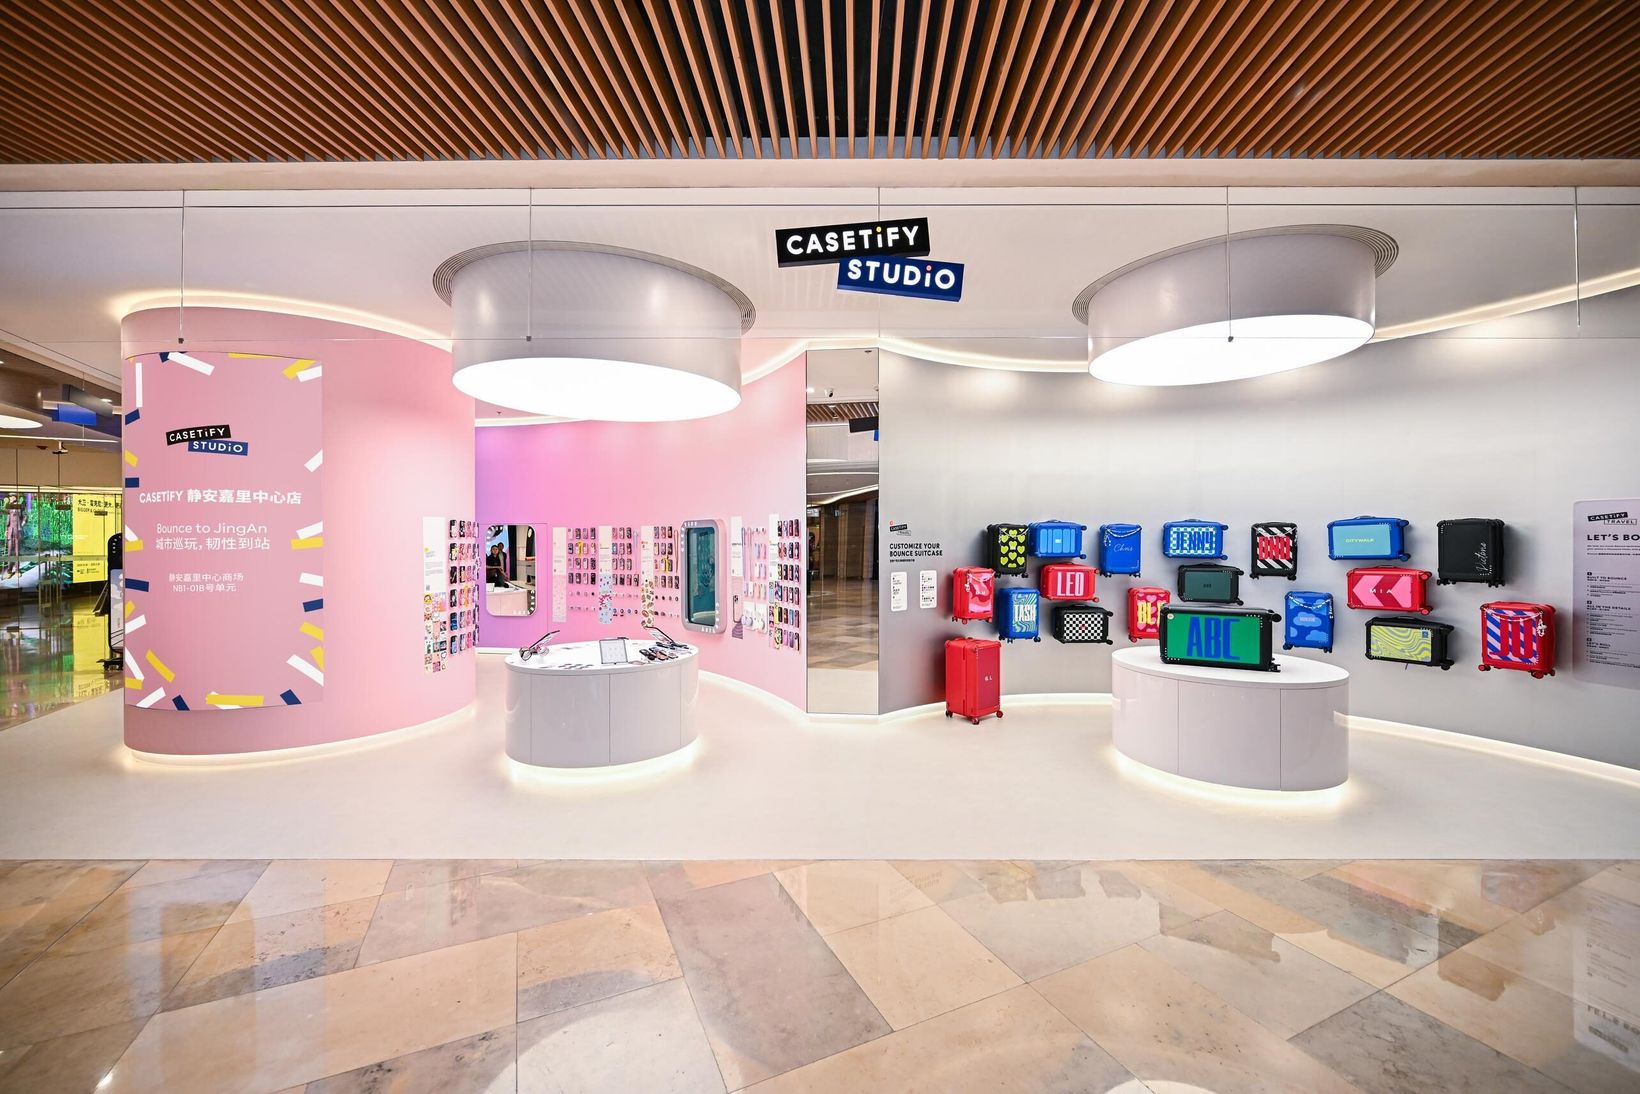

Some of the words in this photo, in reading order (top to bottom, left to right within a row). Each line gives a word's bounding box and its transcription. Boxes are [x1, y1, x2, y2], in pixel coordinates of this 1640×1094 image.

[187, 488, 303, 505] 静安嘉里中心店
[156, 523, 192, 534] Bounce
[195, 523, 210, 534] to
[213, 522, 267, 536] JingAn
[1587, 533, 1619, 541] LET'S
[1113, 543, 1133, 552] Chris
[1173, 531, 1214, 551] JENNY
[1056, 571, 1085, 597] LEO
[1013, 604, 1037, 622] TASH
[1186, 616, 1241, 660] ABC
